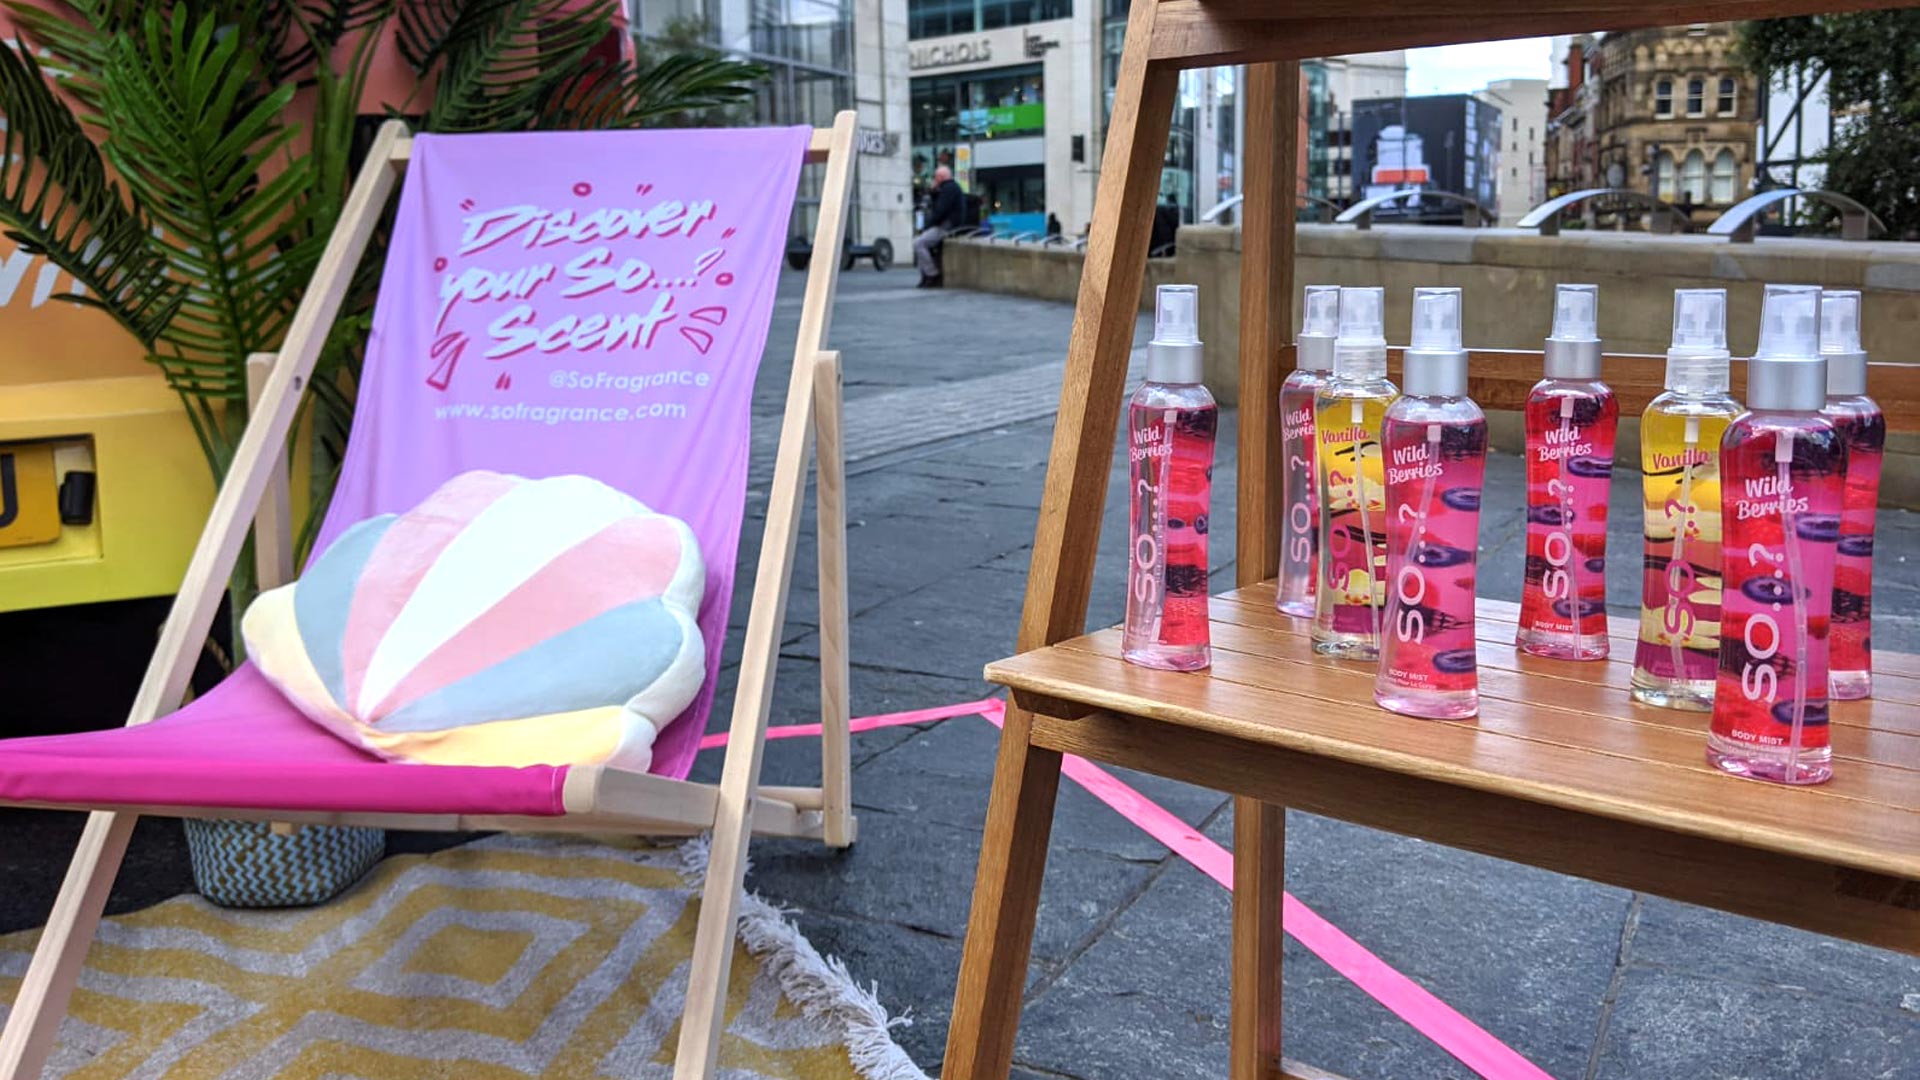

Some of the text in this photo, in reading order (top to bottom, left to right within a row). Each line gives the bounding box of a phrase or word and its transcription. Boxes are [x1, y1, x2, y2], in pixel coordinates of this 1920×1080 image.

[909, 39, 991, 71] NICHOLS
[459, 200, 717, 257] Discover
[435, 265, 556, 335] your
[484, 293, 678, 360] Scent
[550, 369, 710, 394] @SoFragrance
[434, 400, 687, 425] www.sofragrance.com
[1286, 408, 1312, 426] Wild
[1134, 426, 1162, 445] Wild
[1283, 422, 1315, 441] Berrie
[1322, 427, 1370, 444] Vanilla
[1545, 426, 1581, 445] Wild
[1131, 440, 1172, 462] Berries
[1393, 443, 1430, 466] Wild
[1538, 442, 1592, 462] Berries
[1653, 448, 1710, 470] Vanilla
[1387, 461, 1443, 485] Berries
[1745, 477, 1794, 498] Wild
[1736, 495, 1809, 520] Berries
[1409, 672, 1428, 681] MIST
[1731, 729, 1784, 745] BODY MIST
